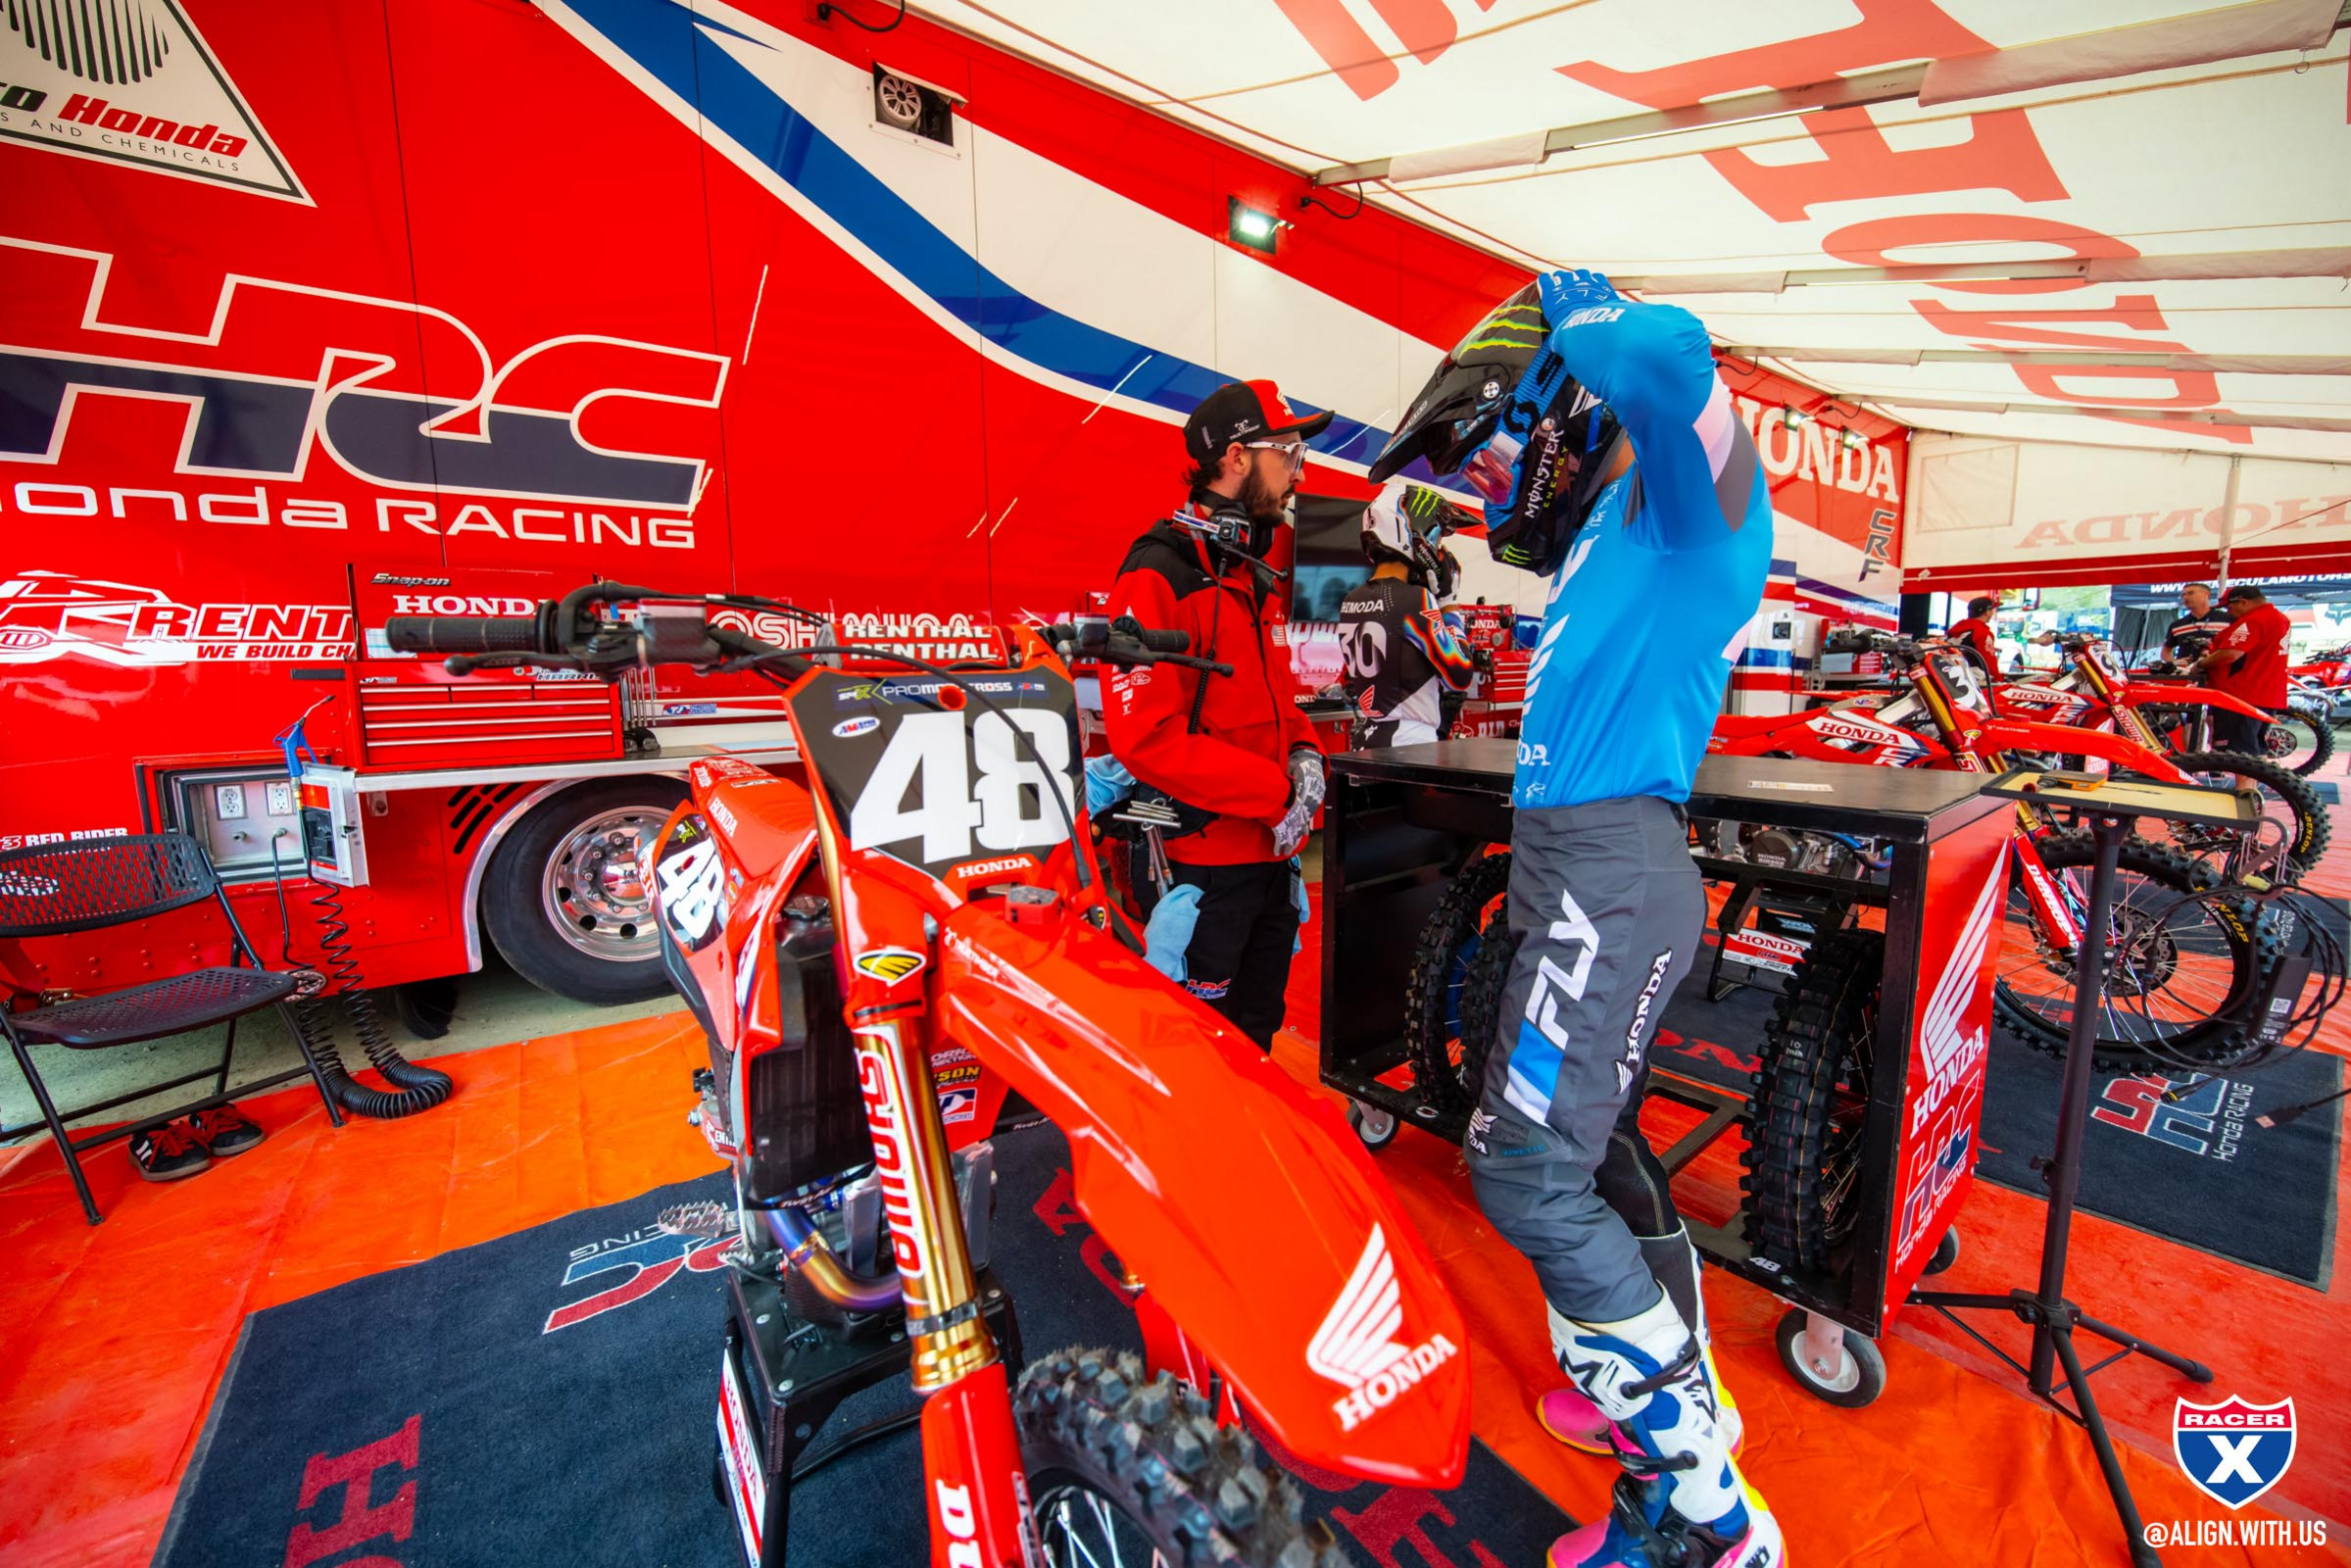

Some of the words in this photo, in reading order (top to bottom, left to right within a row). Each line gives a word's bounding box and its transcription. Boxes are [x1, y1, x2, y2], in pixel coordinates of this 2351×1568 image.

[30, 119, 82, 137] AND
[101, 133, 239, 172] CHEMICALS
[58, 93, 248, 158] Honda
[1525, 429, 1565, 518] MONSTER
[1543, 446, 1568, 508] ENERGY
[0, 481, 349, 531] onda
[376, 498, 696, 549] RACING
[370, 573, 452, 588] Snap-on
[392, 595, 540, 615] HOND
[196, 645, 238, 659] WE
[245, 645, 313, 659] BUILD
[2010, 691, 2074, 703] HONDA
[1818, 721, 1901, 745] HONDA
[851, 708, 1076, 864] 48
[955, 855, 1033, 879] HONDA
[1738, 933, 1805, 956] HONDA
[1626, 950, 1673, 1063] HONDA
[1909, 1026, 1985, 1140] HONDA
[2224, 1082, 2255, 1122] RACING
[2211, 1120, 2245, 1162] Honda
[1895, 1211, 1934, 1274] Honda
[1933, 1153, 1968, 1214] RACING
[1748, 1256, 1782, 1273] 48
[1330, 1334, 1459, 1433] HONDA
